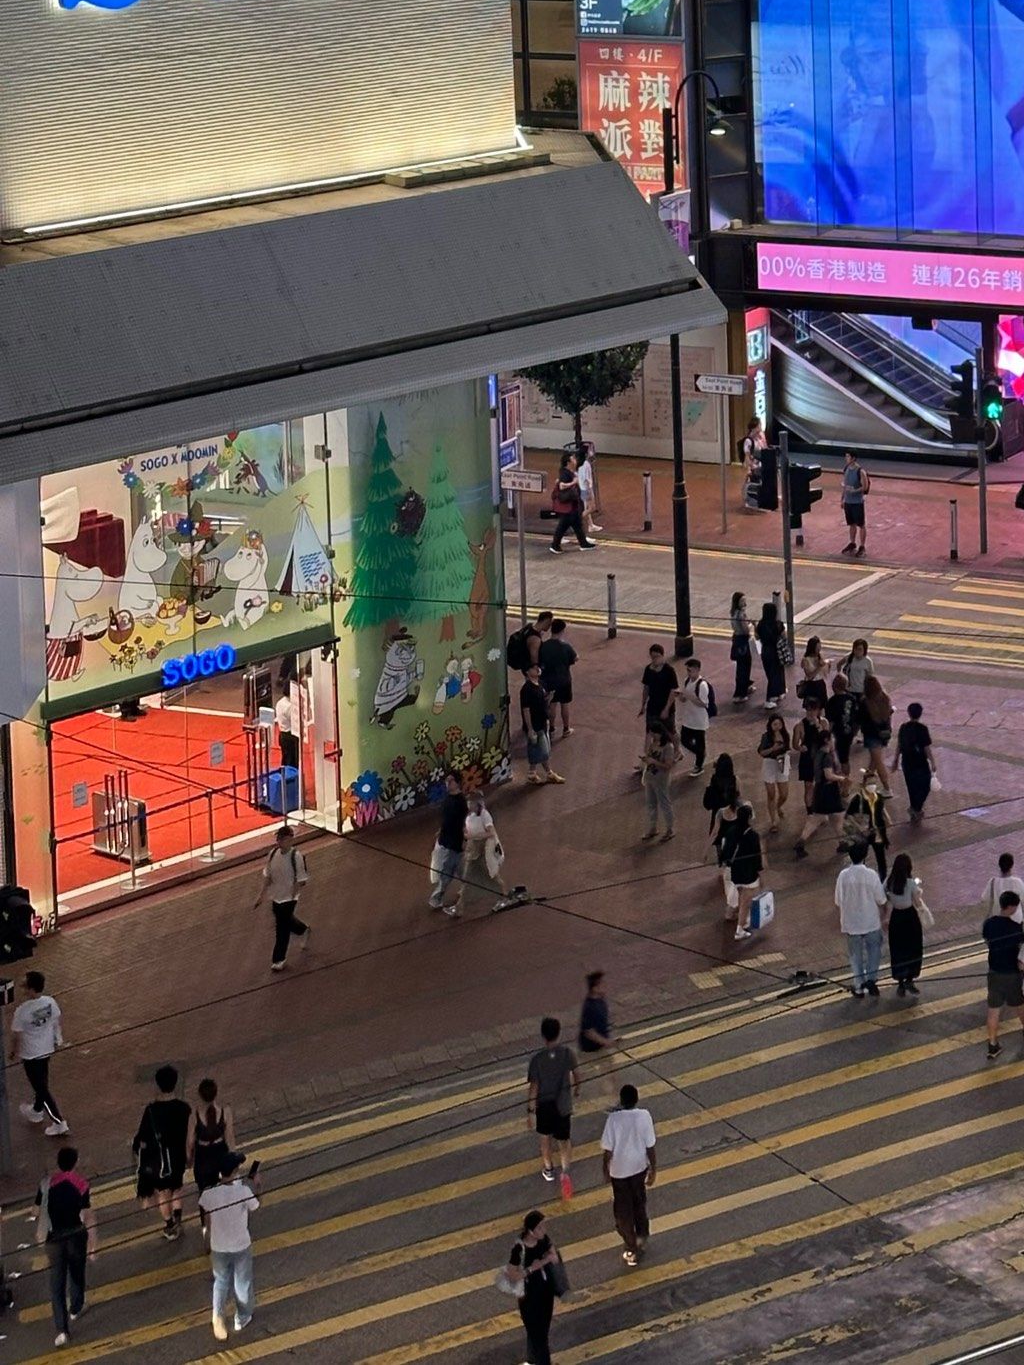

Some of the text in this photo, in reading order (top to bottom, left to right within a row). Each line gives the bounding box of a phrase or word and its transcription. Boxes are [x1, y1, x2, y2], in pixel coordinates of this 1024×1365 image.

[599, 47, 663, 63] 四樓 4/F
[598, 70, 671, 112] 麻辣
[599, 117, 664, 160] 派對
[140, 444, 218, 472] SOGO X MOOMIN
[162, 644, 235, 686] SOGO
